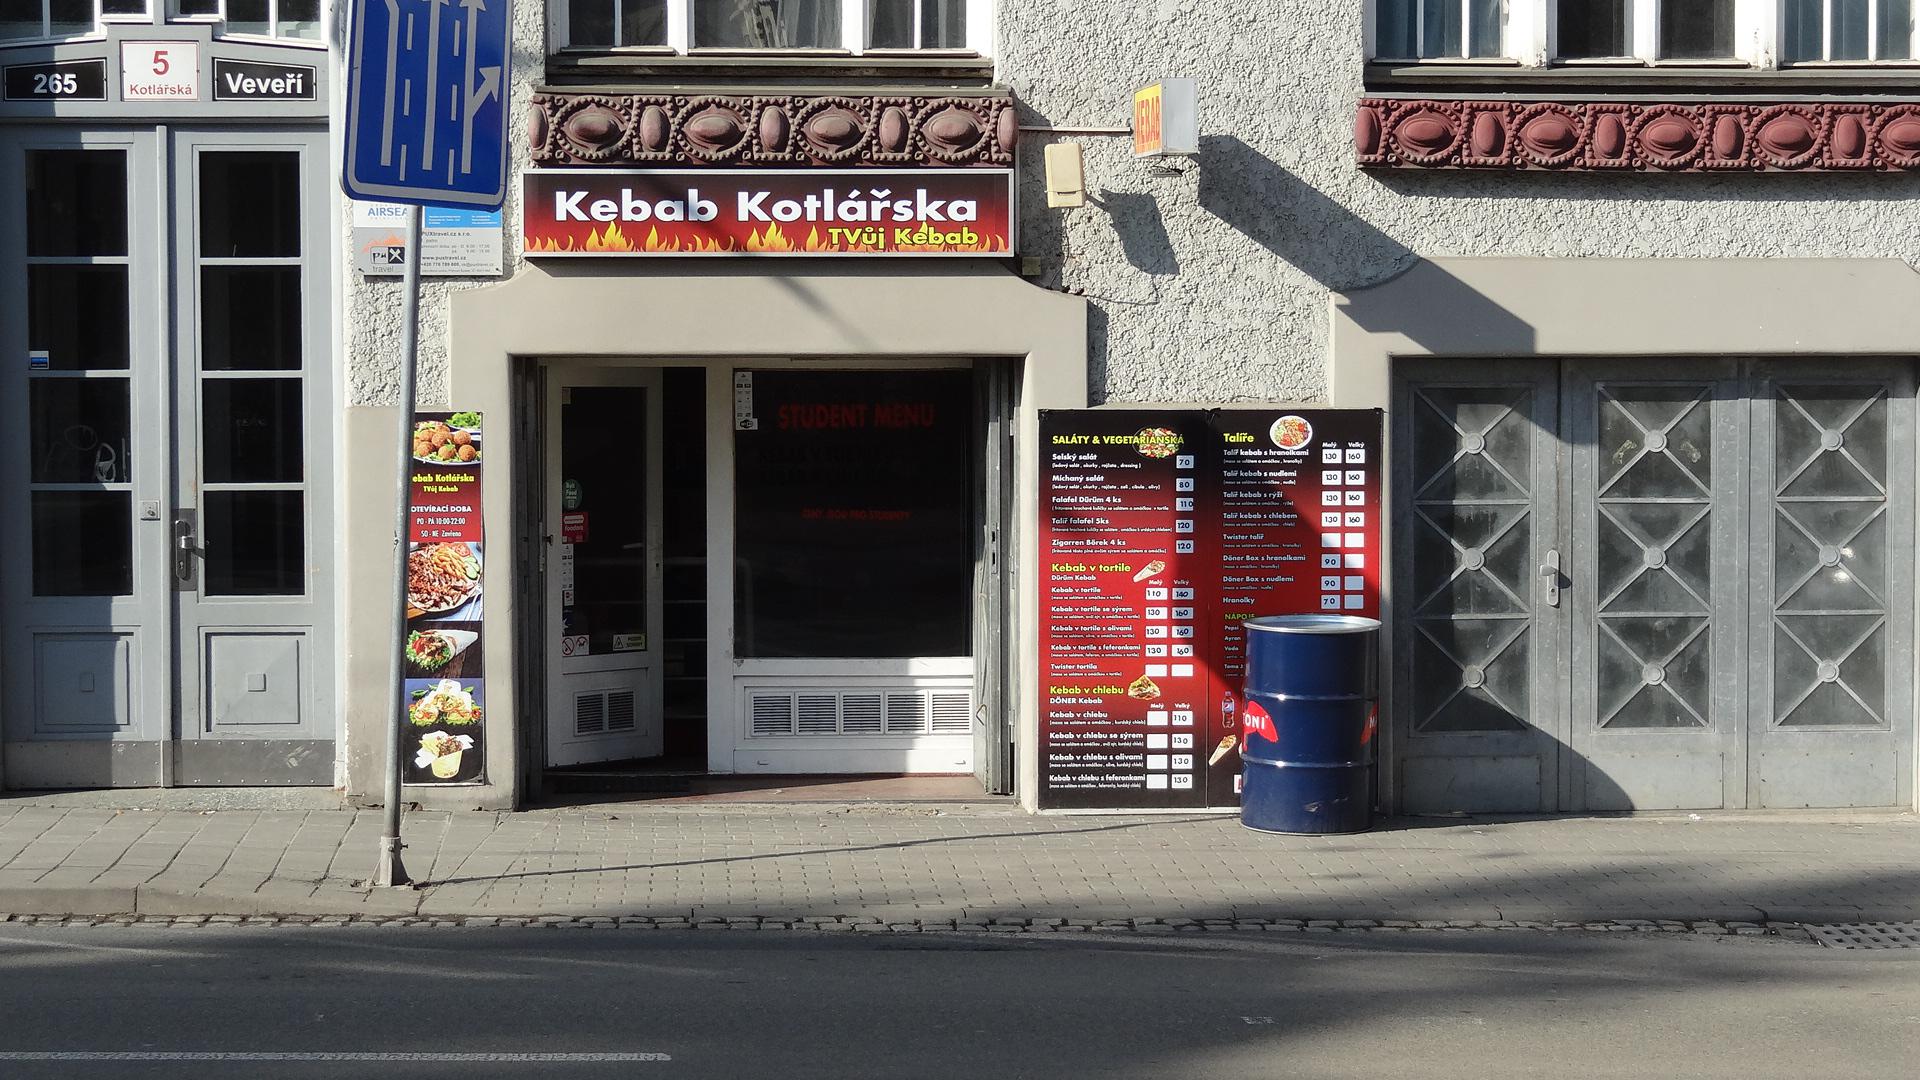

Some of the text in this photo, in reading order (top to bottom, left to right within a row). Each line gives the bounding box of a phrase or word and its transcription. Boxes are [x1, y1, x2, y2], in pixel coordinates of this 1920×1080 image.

[152, 51, 169, 75] 5
[34, 74, 77, 93] 265
[130, 83, 192, 95] Kotlářská
[225, 73, 302, 93] Veveří
[1136, 96, 1160, 144] KEBAB
[555, 189, 976, 222] Kebab Kotlářska
[828, 226, 978, 249] TVůj Kebab
[777, 403, 934, 430] STUDENT MENU
[1053, 434, 1089, 444] SALÁTY
[1092, 436, 1100, 444] &
[1223, 433, 1255, 443] Talíře
[413, 474, 474, 482] ebab Kotlářska
[1052, 539, 1084, 547] Zigarren
[1052, 563, 1087, 572] Kebab
[1050, 685, 1083, 694] Kebab
[1094, 685, 1123, 694] chlebu
